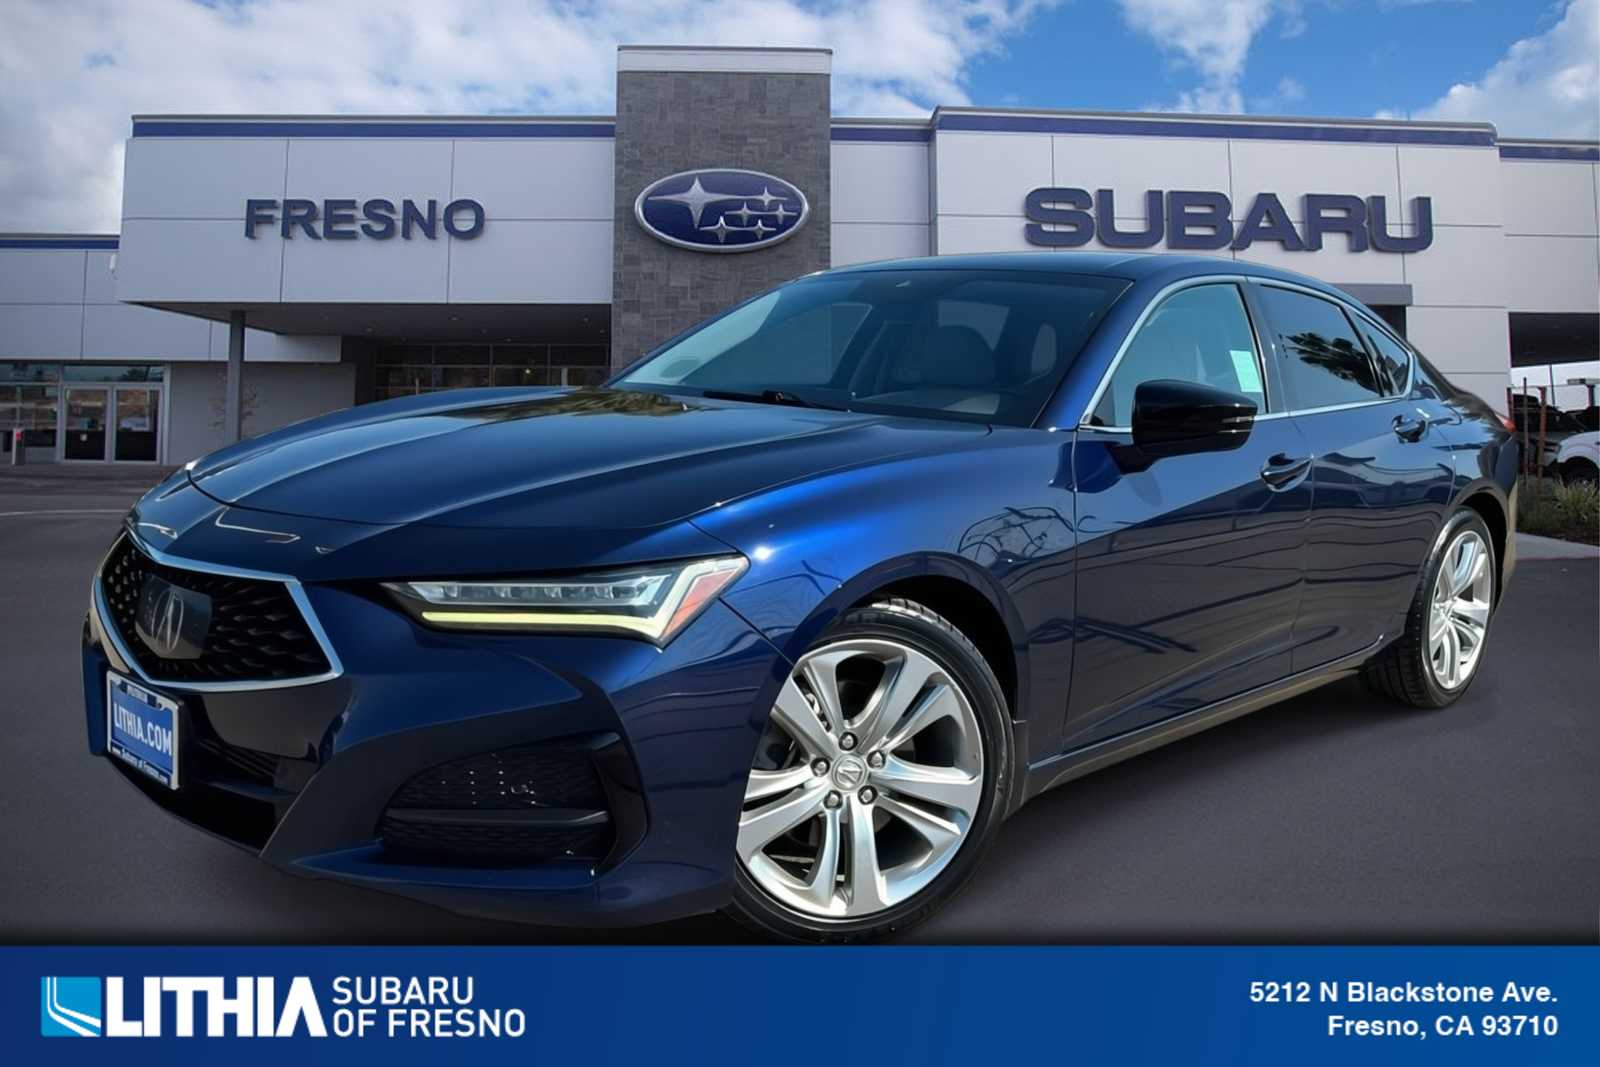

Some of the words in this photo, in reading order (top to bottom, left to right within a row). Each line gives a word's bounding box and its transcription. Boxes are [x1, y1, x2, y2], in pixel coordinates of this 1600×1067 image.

[244, 198, 486, 241] FRESNO
[1024, 187, 1434, 254] SUBARU
[113, 702, 172, 756] LITHIA.COM
